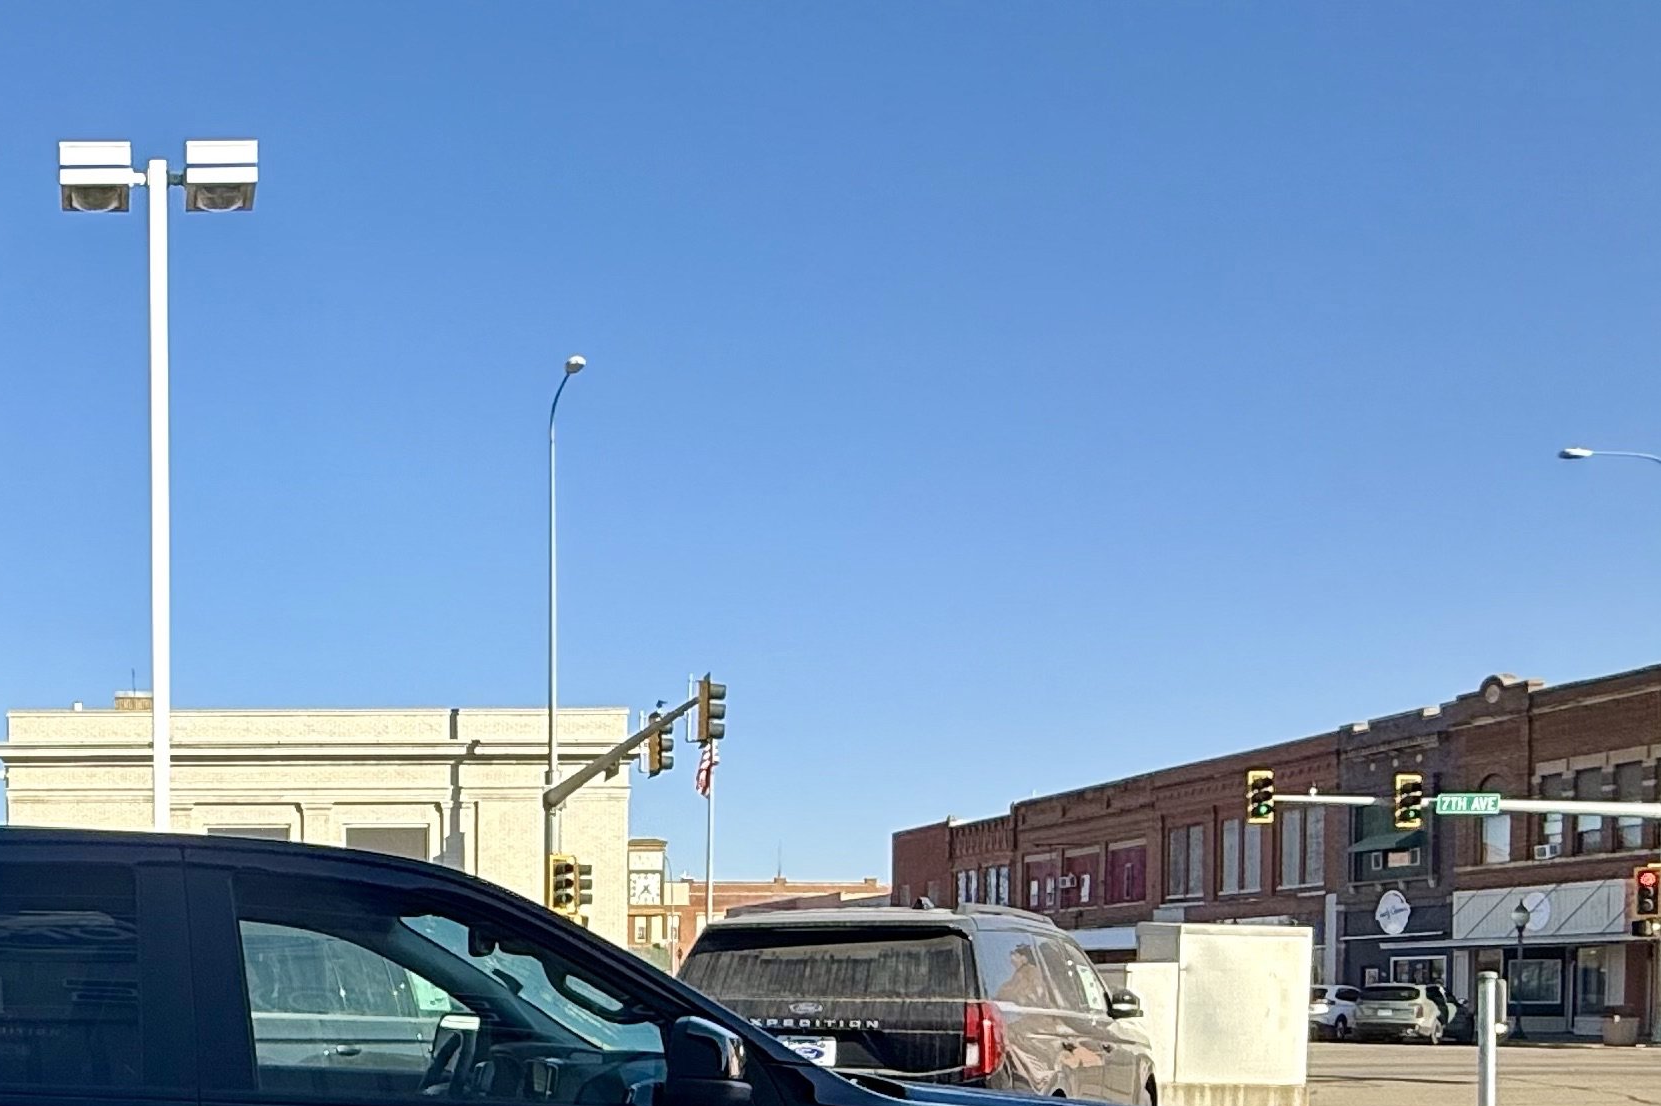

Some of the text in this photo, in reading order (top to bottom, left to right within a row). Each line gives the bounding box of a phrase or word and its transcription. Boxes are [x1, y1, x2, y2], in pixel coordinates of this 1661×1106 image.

[1441, 796, 1497, 811] 7TH AVE
[750, 1018, 879, 1028] XPEDITION
